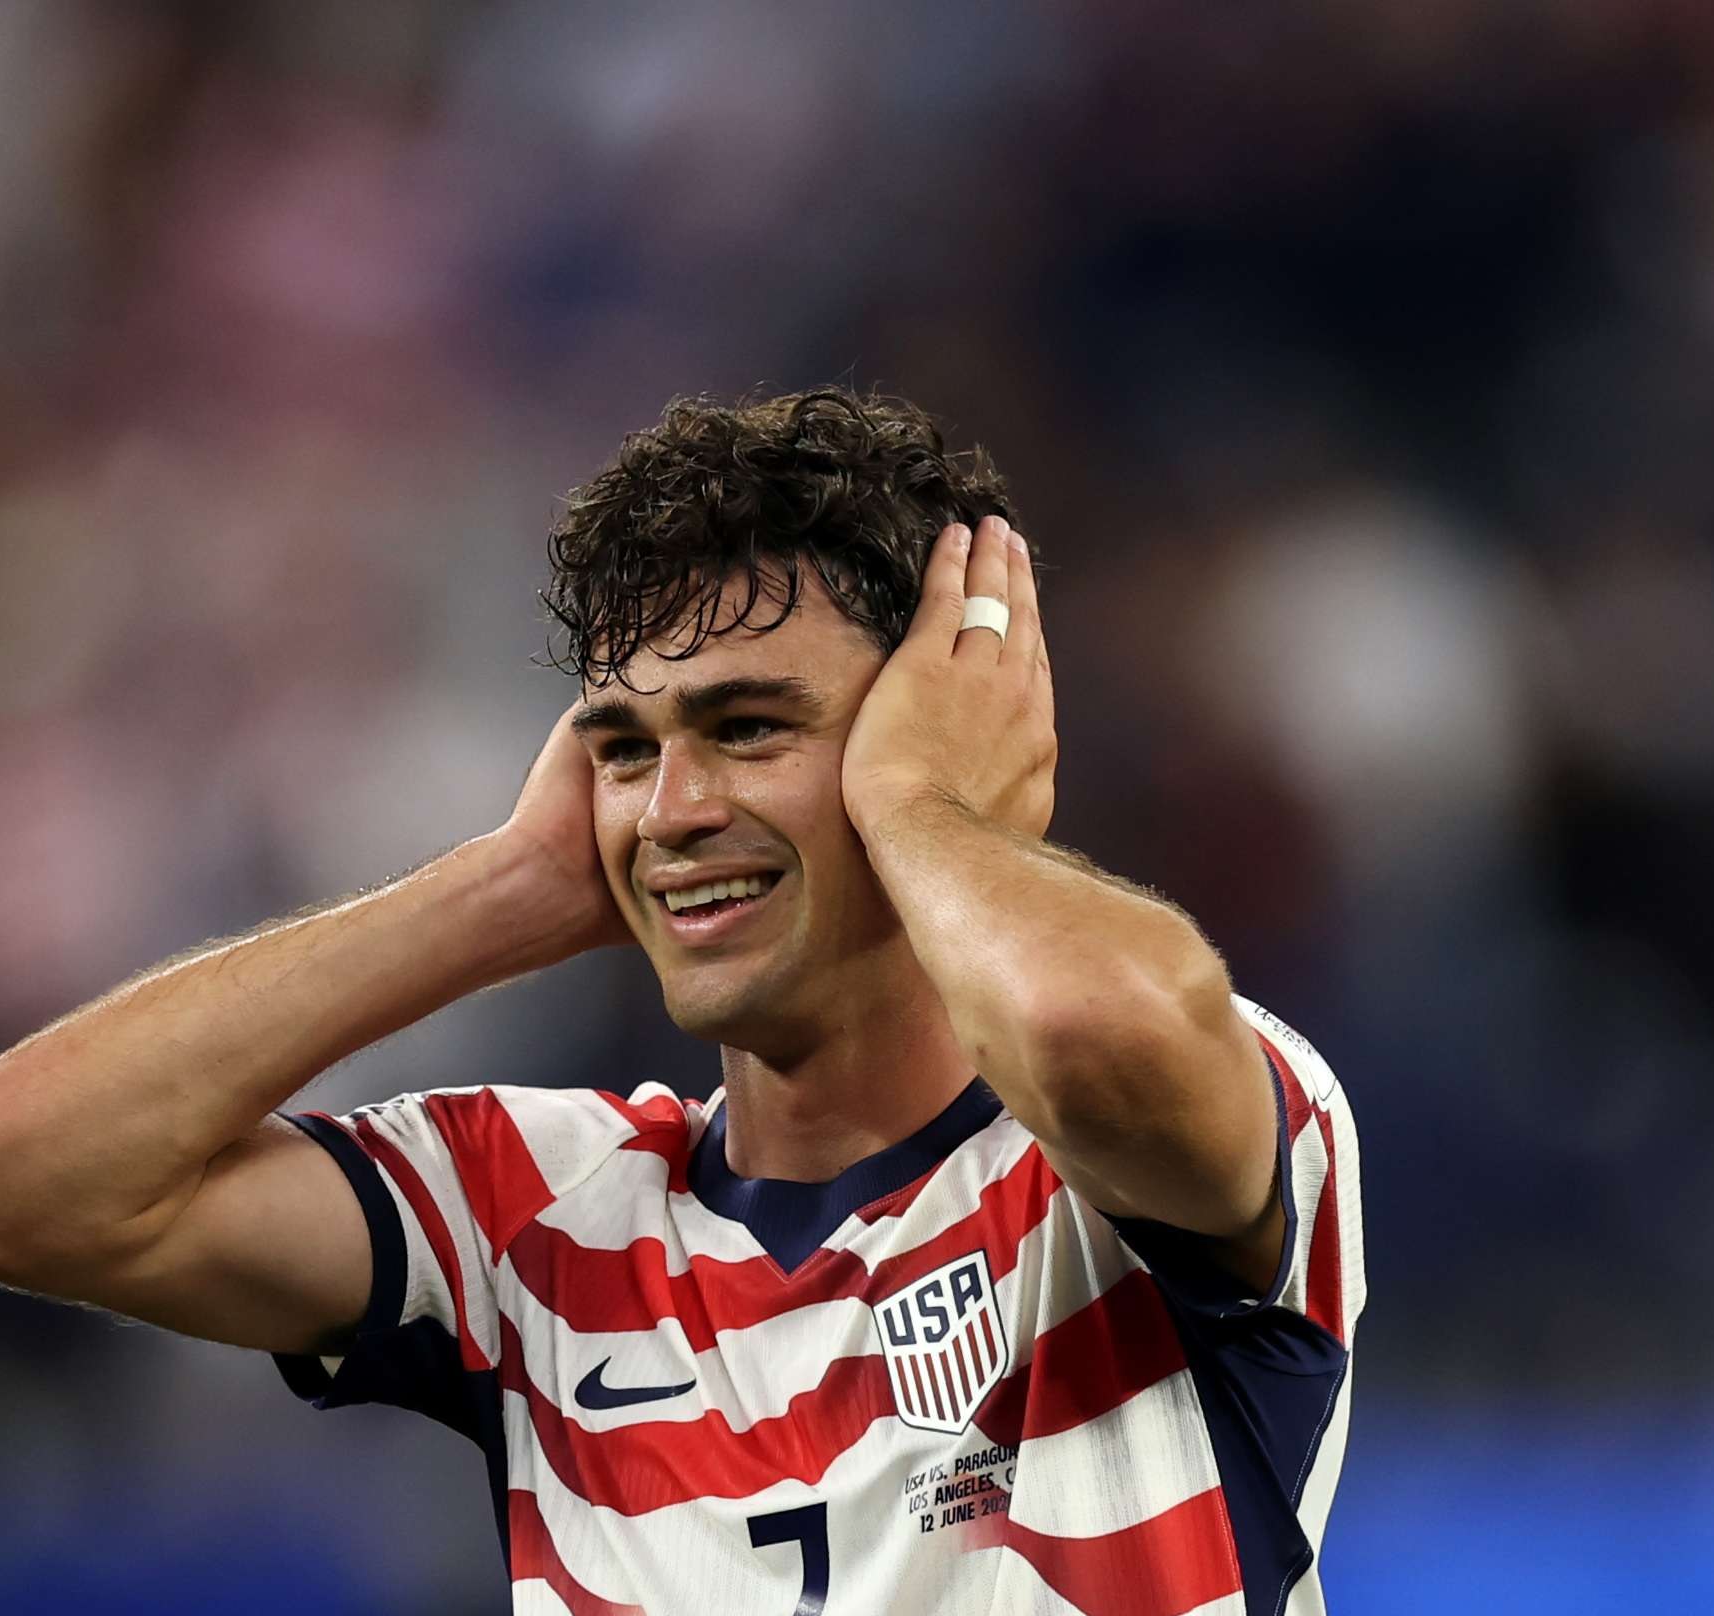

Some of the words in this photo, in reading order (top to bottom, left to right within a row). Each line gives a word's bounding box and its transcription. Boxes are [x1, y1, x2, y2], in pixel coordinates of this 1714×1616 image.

[883, 1262, 983, 1346] USA
[905, 1472, 926, 1494] USA
[929, 1463, 948, 1483] VS.
[954, 1444, 1020, 1477] PARAGUA
[909, 1491, 928, 1514] LOS
[920, 1513, 934, 1533] 12
[940, 1501, 975, 1528] JUNE
[981, 1492, 1012, 1516] 202
